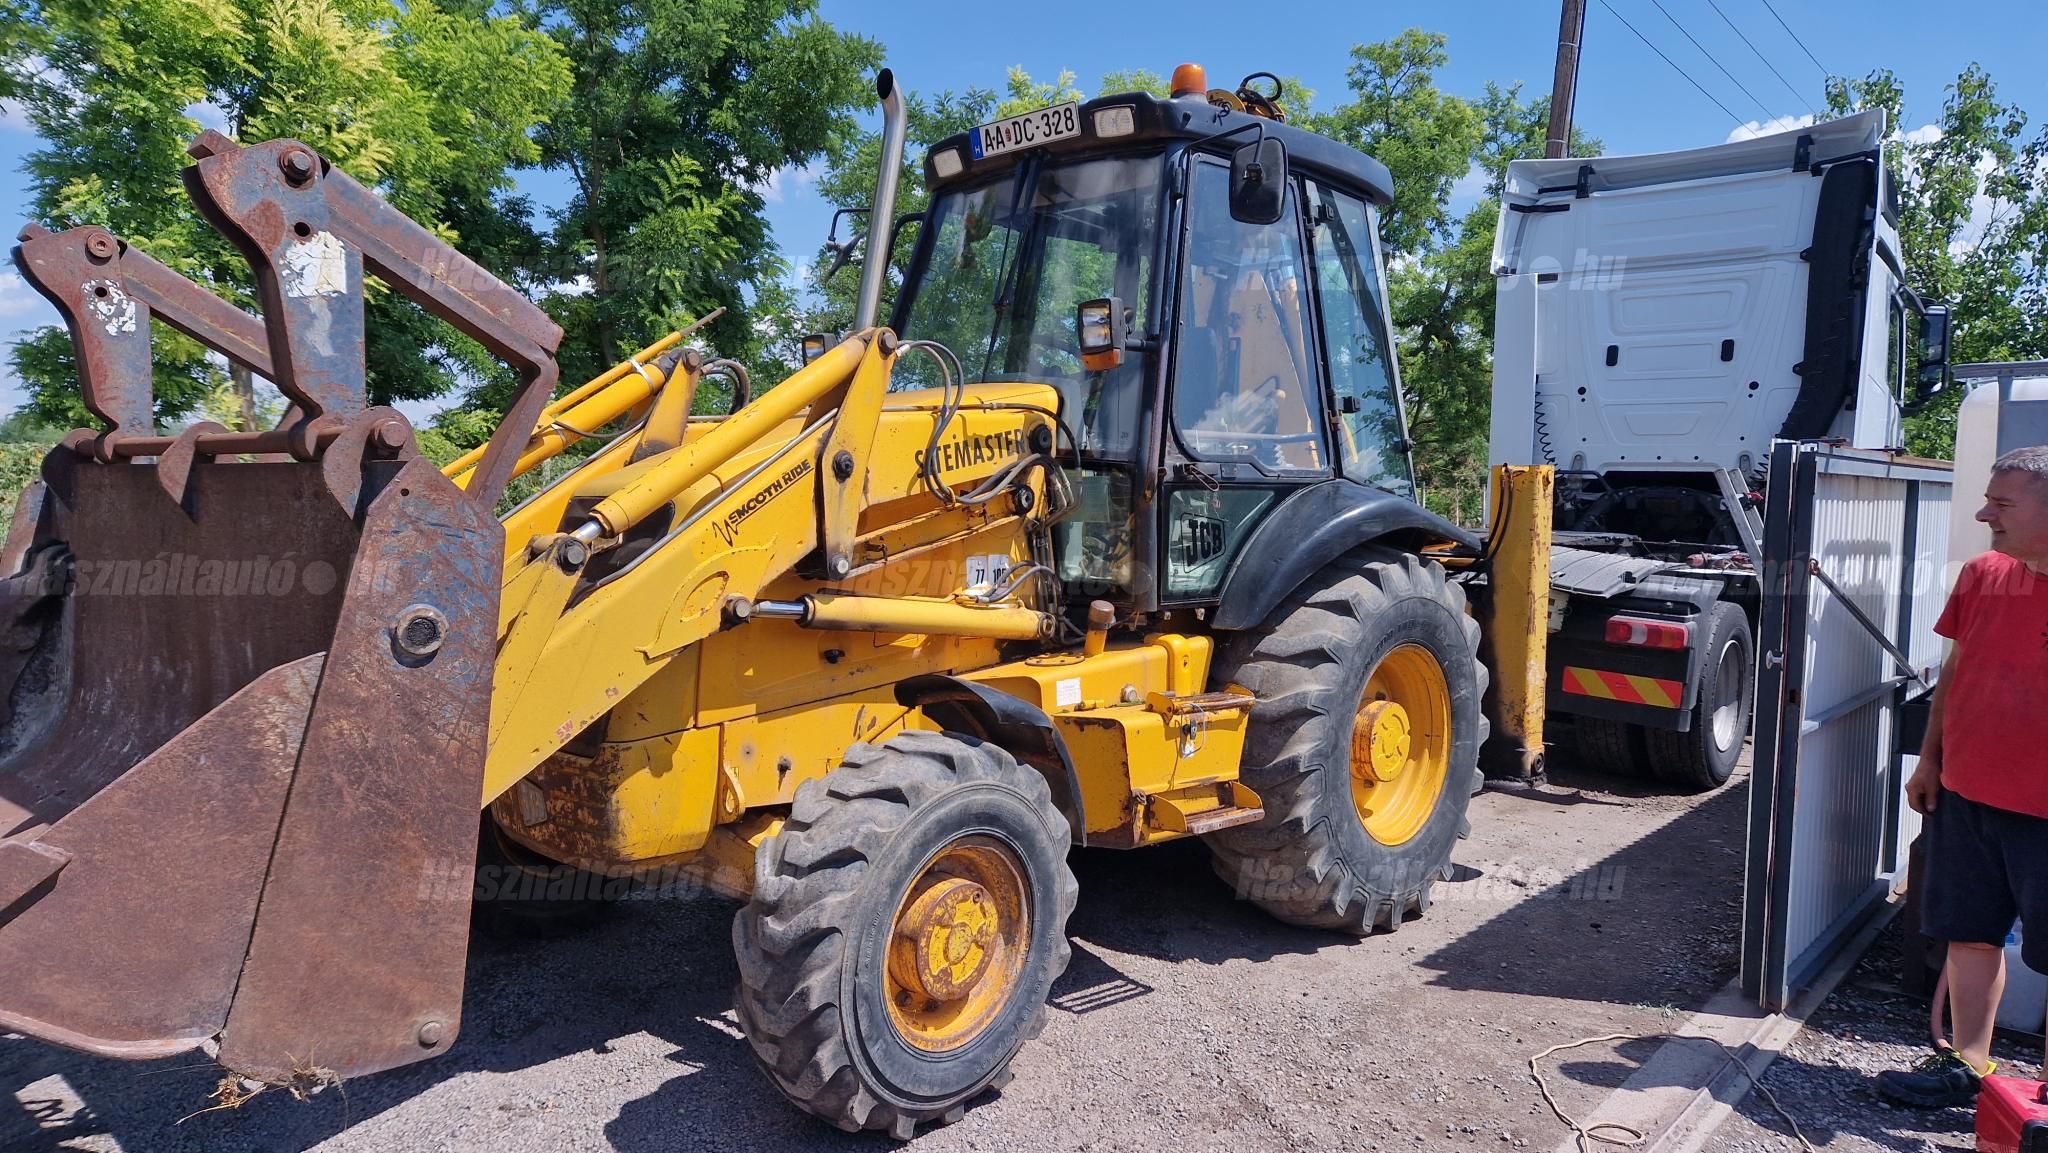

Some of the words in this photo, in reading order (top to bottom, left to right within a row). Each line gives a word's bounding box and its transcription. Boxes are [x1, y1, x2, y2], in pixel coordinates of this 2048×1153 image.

[1012, 107, 1075, 145] DC-328
[914, 428, 1026, 478] STEMASTER
[728, 479, 783, 524] SMOOTH
[782, 459, 811, 485] RIDE
[1186, 519, 1222, 567] JCB
[975, 568, 985, 584] 77
